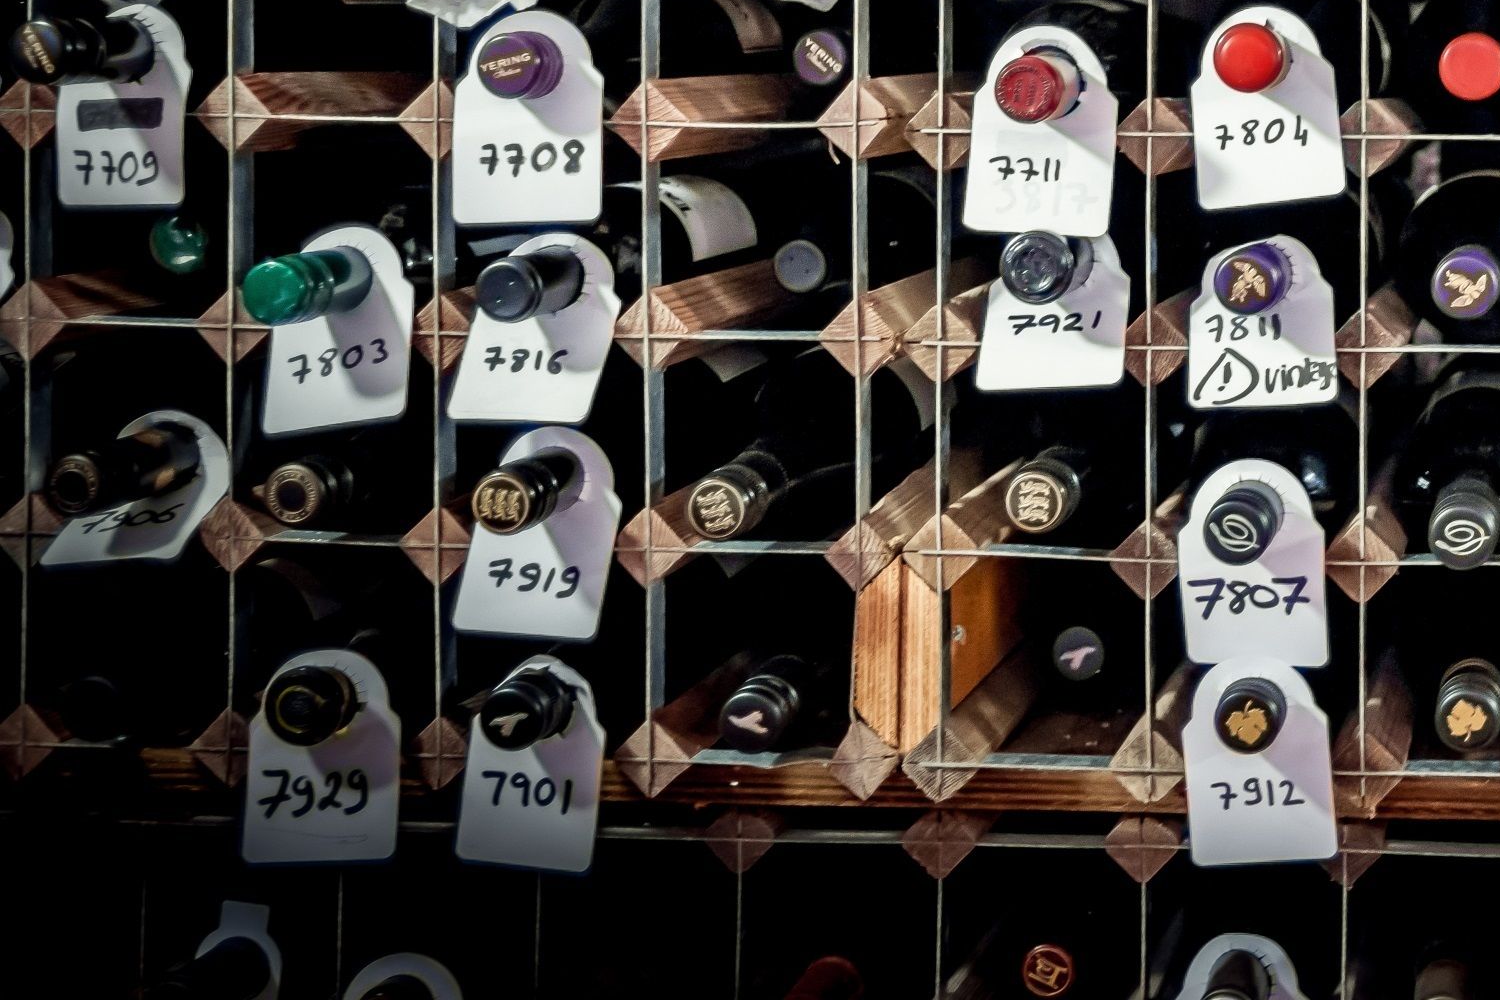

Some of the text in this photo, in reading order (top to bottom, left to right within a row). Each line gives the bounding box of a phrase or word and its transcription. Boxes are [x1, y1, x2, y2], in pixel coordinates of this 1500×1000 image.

[22, 24, 55, 75] YERING
[480, 52, 531, 71] YERING
[804, 37, 842, 73] YERING
[1215, 116, 1308, 149] 7804
[75, 149, 159, 185] 7709
[480, 140, 585, 177] 7708
[989, 156, 1061, 182] 7711
[1008, 310, 1102, 334] 7921
[1206, 314, 1281, 341] 7811
[287, 338, 389, 384] 7803
[484, 346, 568, 374] 7816
[489, 558, 580, 599] 7919
[1188, 577, 1310, 620] 7807
[258, 769, 368, 818] 7929
[482, 771, 573, 815] 7901
[1210, 778, 1305, 810] 7912
